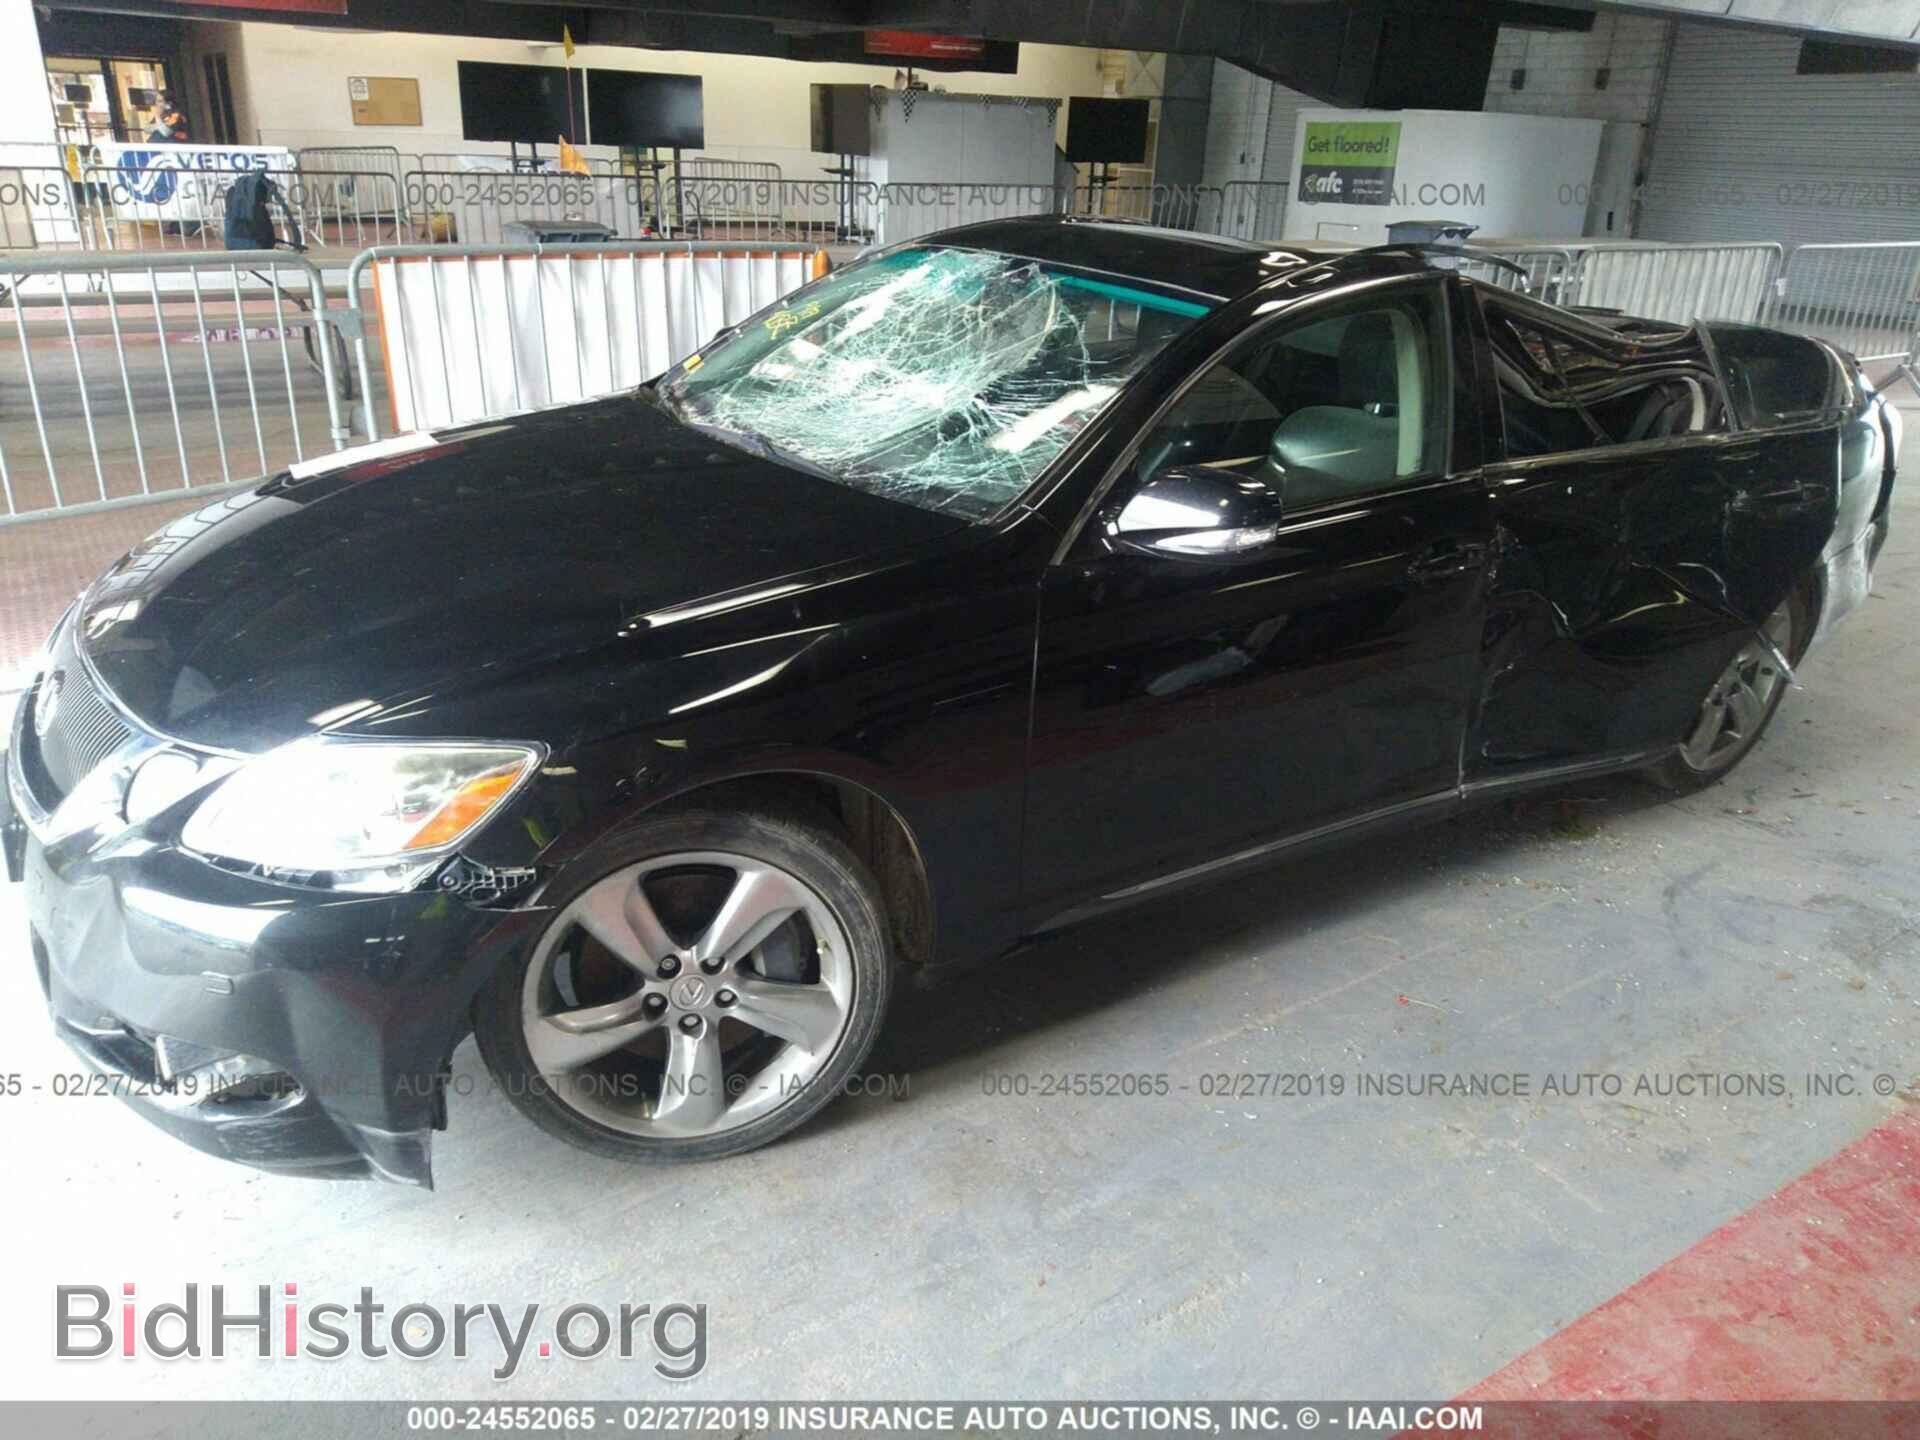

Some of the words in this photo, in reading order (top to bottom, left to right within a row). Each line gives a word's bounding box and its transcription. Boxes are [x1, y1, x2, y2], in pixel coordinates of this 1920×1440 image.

[1307, 136, 1329, 152] Get
[1334, 136, 1390, 153] floored!
[1316, 171, 1343, 193] afc
